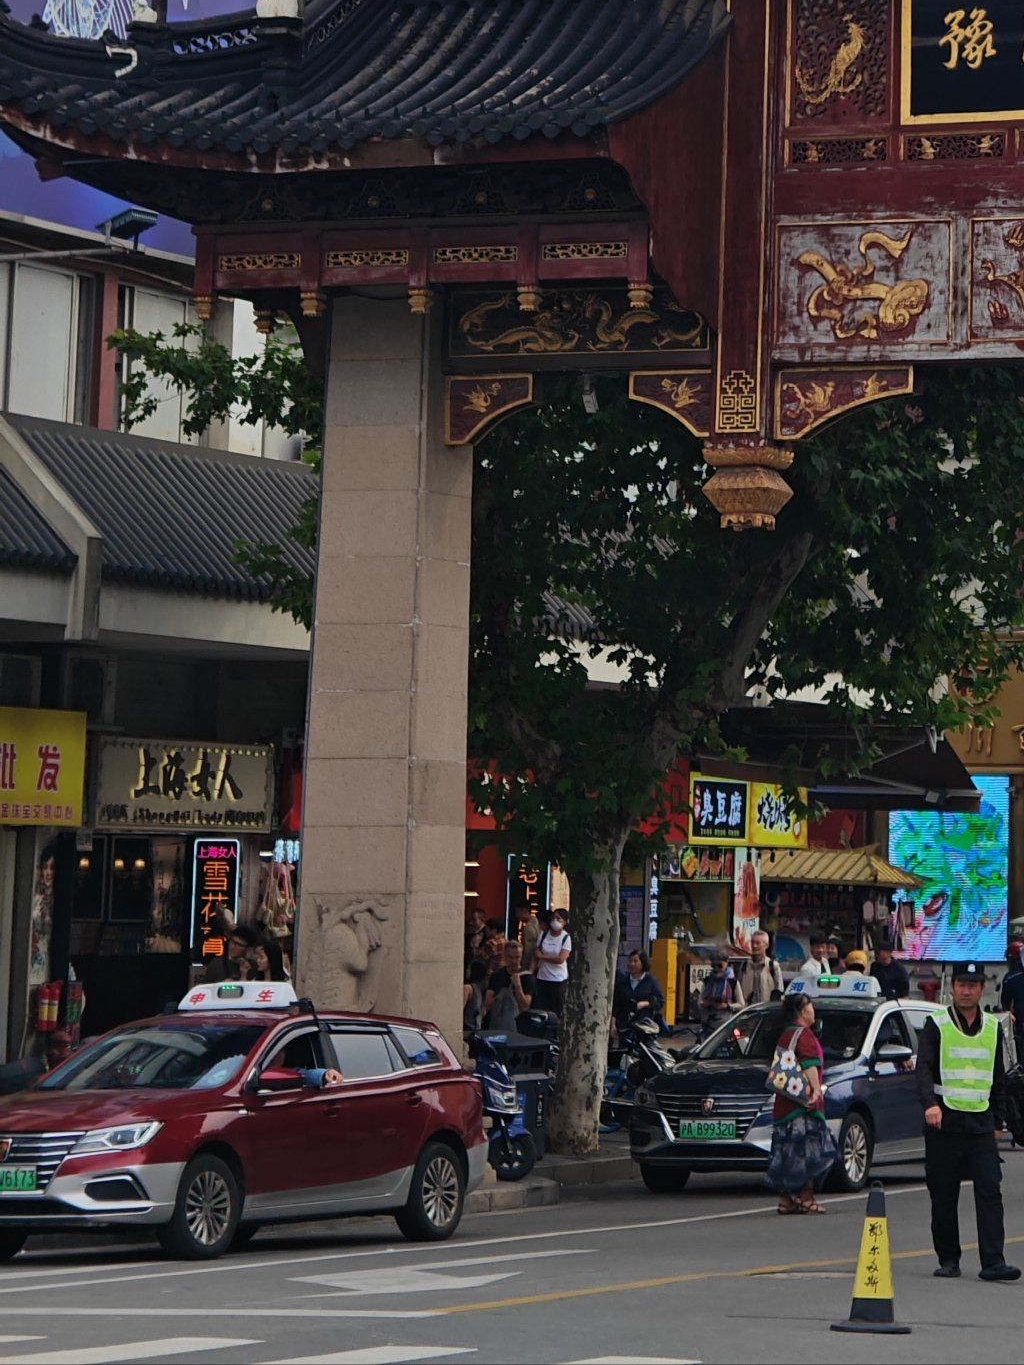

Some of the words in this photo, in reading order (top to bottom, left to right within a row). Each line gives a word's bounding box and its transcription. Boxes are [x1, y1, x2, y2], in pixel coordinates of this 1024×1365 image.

[130, 747, 243, 802] 上海女人
[700, 787, 743, 828] 臭豆腐
[198, 845, 238, 859] 上海女人
